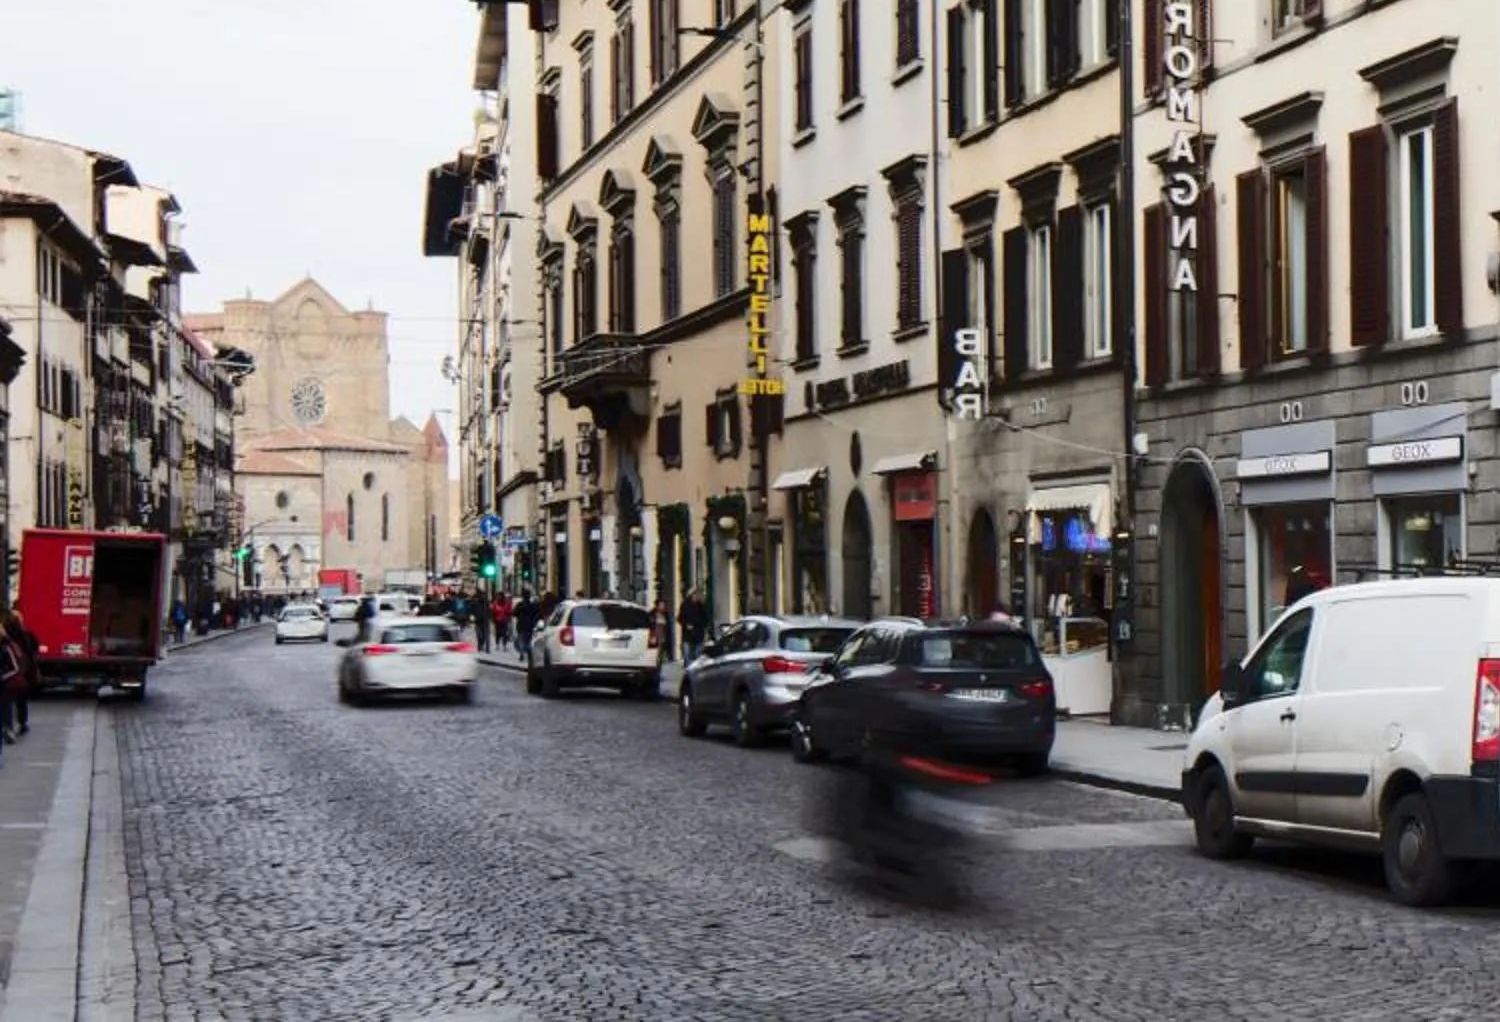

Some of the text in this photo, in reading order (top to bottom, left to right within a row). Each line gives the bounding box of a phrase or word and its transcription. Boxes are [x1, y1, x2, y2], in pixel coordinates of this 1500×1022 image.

[749, 214, 771, 374] MARTELLI
[1391, 443, 1433, 461] GEOX
[1264, 458, 1297, 474] GEOX
